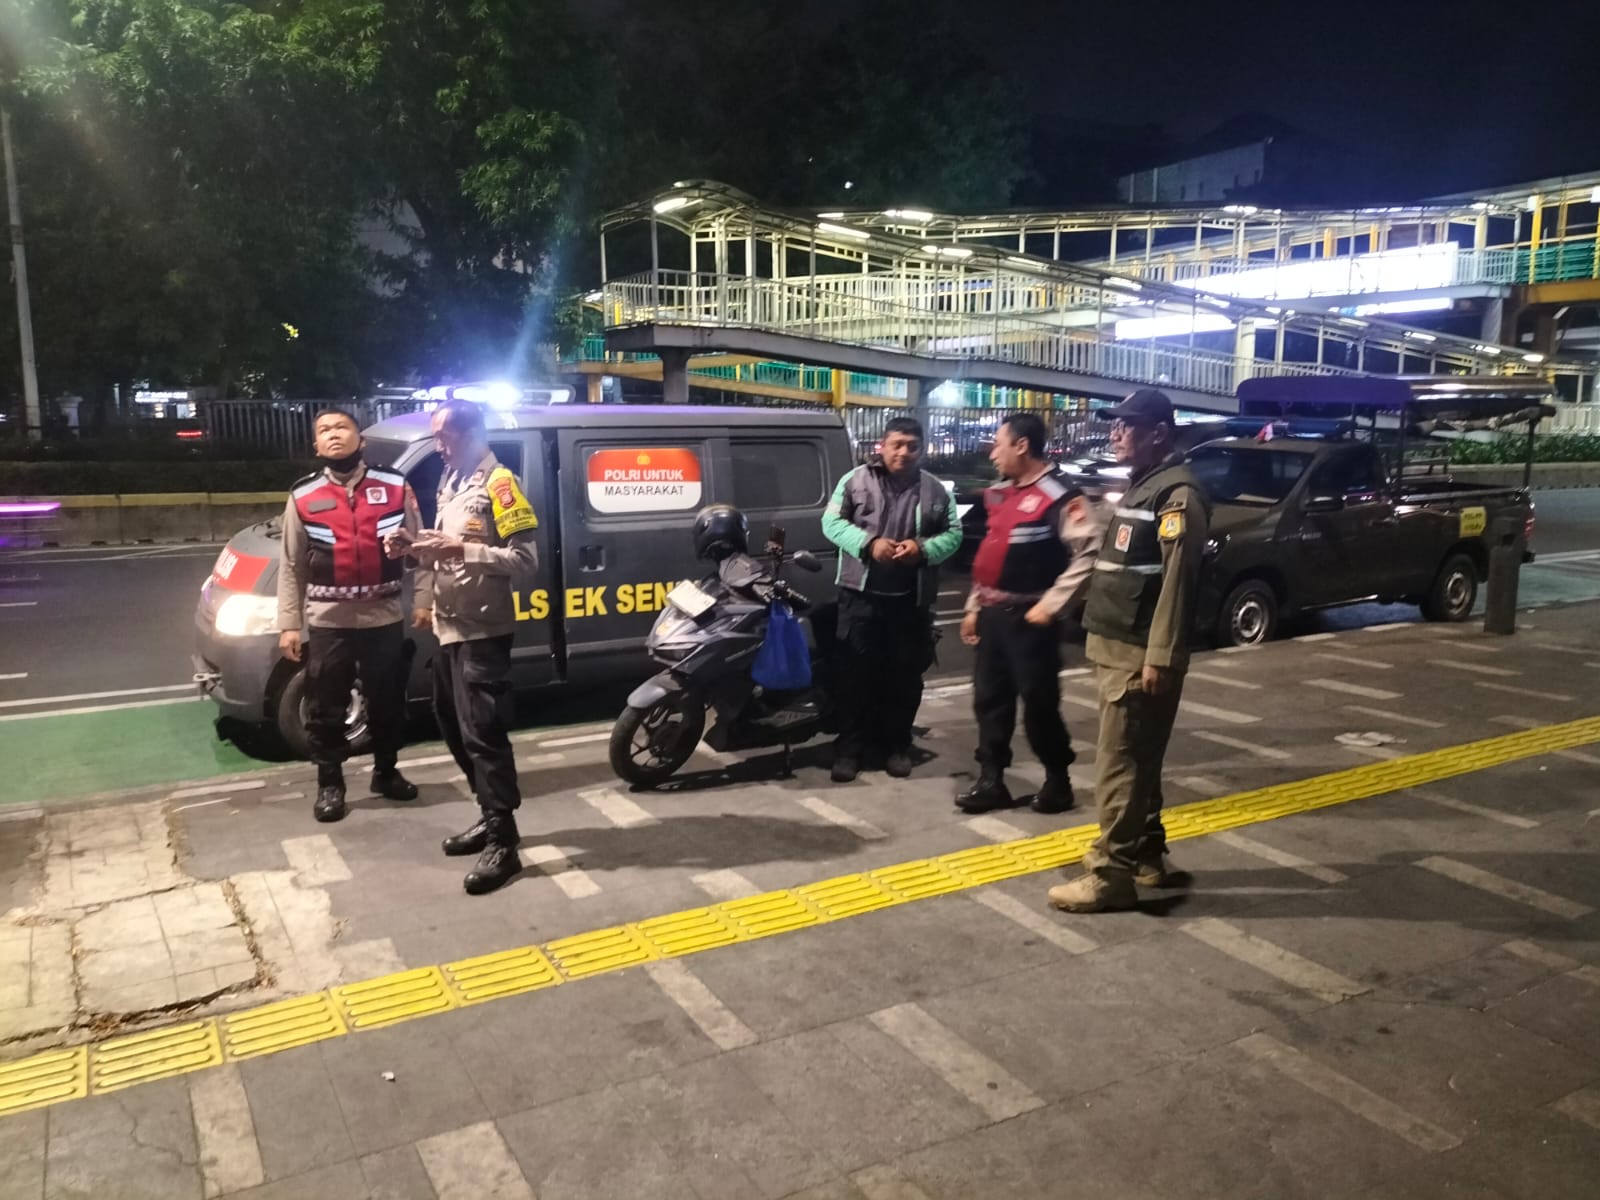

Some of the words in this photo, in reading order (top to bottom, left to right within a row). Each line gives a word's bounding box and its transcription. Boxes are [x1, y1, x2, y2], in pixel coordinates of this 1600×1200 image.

[604, 469, 640, 481] POLRI
[643, 469, 684, 481] UNTUK
[604, 485, 684, 496] MASYARAKAT
[616, 581, 690, 614] SEN
